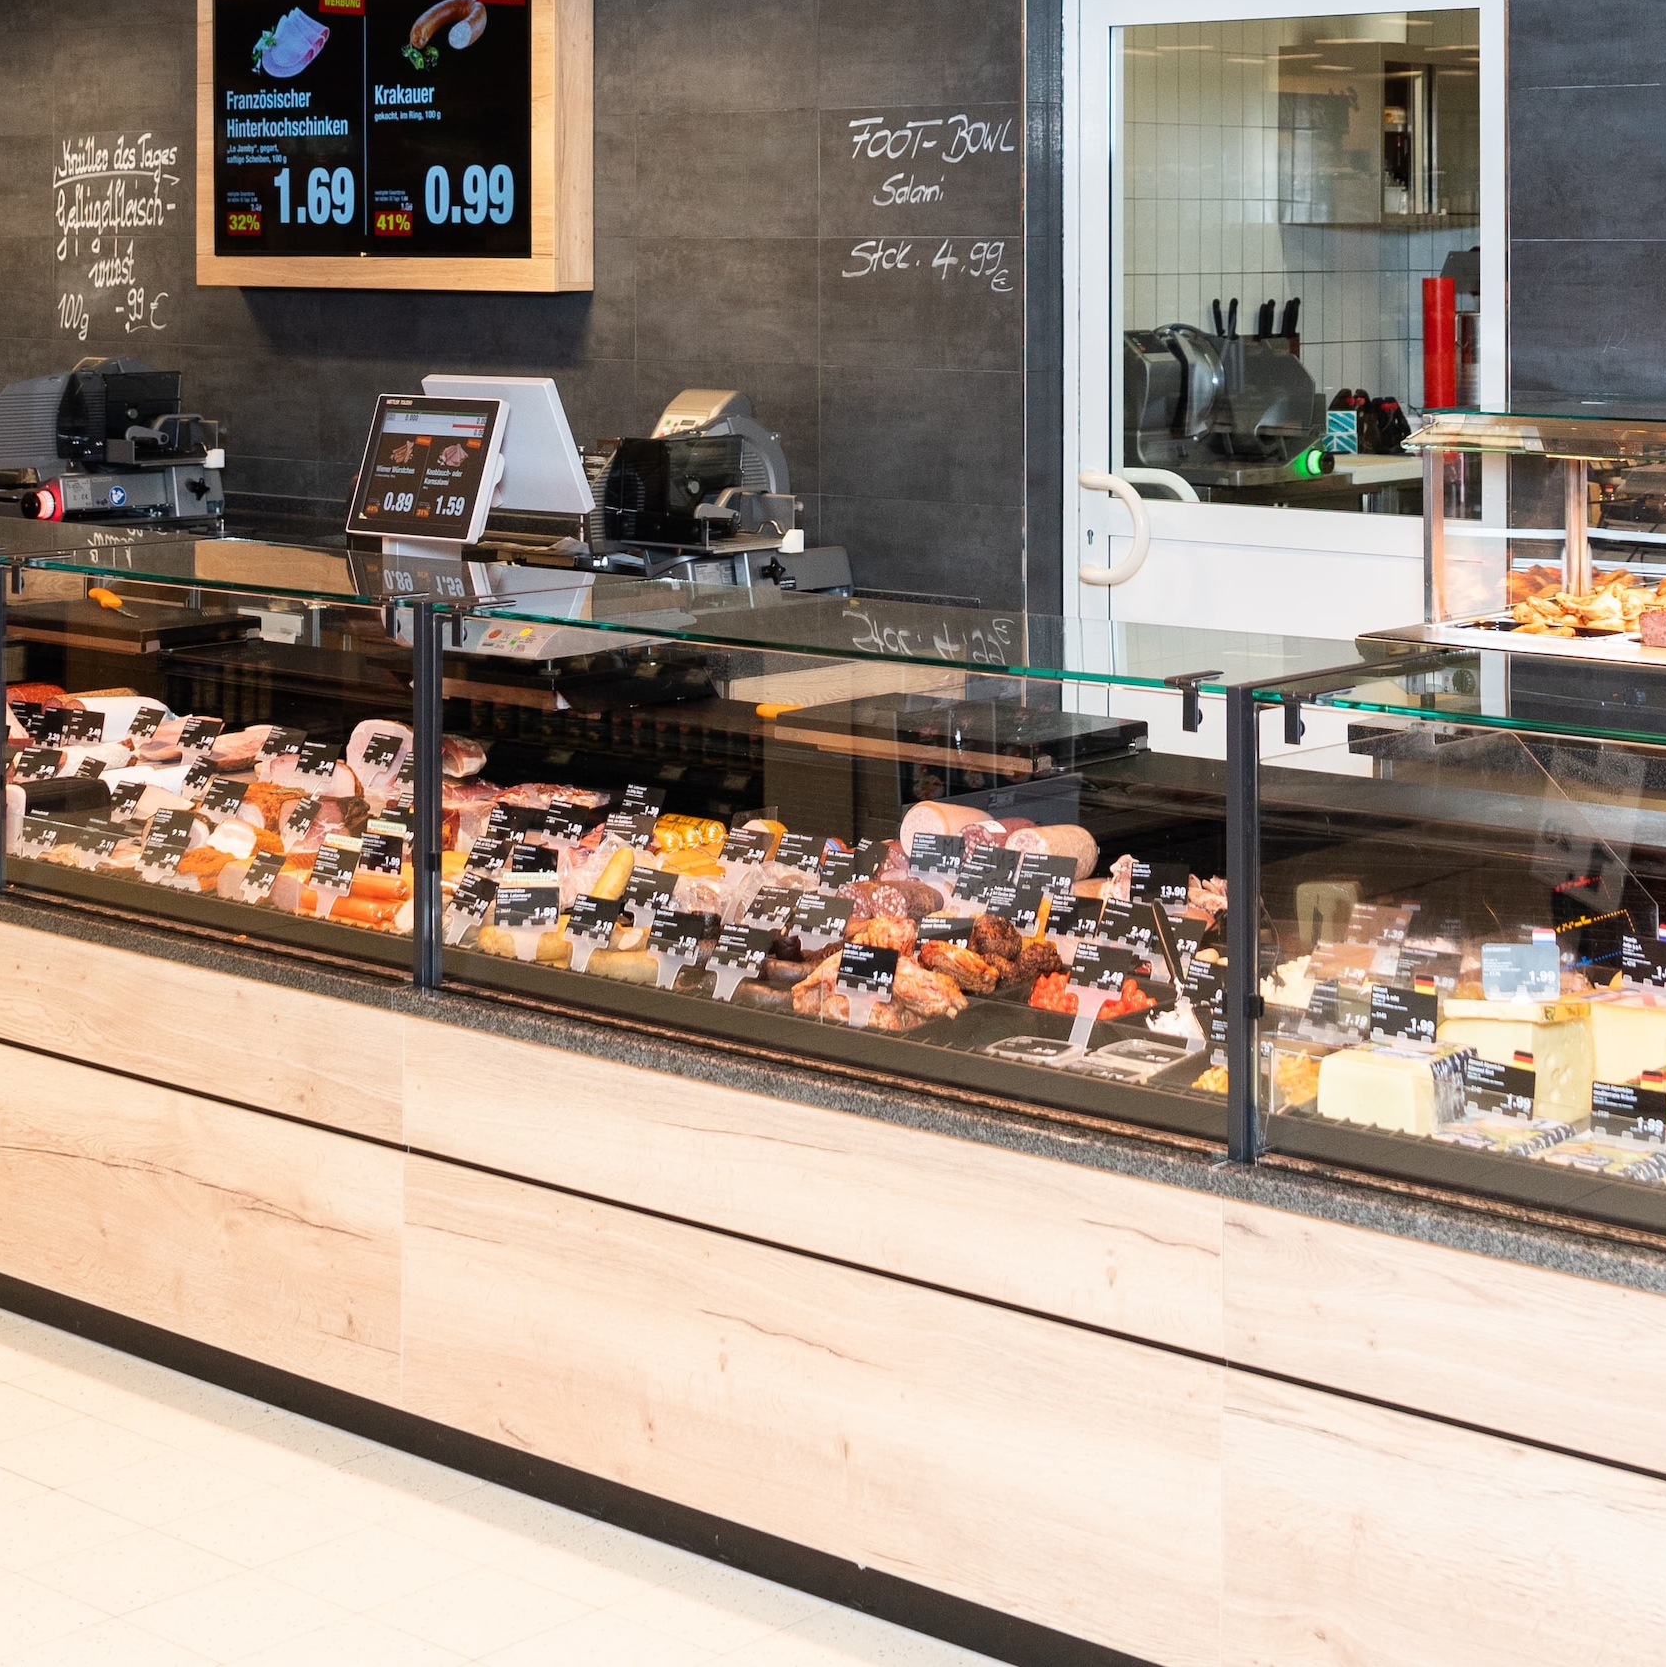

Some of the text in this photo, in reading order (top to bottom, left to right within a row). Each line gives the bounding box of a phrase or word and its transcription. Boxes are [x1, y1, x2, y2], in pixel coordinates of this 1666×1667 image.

[226, 89, 312, 111] Französischer
[374, 83, 435, 106] Krakauer
[226, 116, 348, 138] Hinterkochschinken
[114, 135, 136, 170] des
[138, 133, 178, 183] Tages
[274, 167, 354, 224] 1.69
[425, 164, 514, 224] 0.99
[872, 173, 945, 206] Salami
[229, 215, 260, 230] 32%
[377, 214, 410, 230] 41%
[932, 239, 1005, 280] 4,99
[384, 492, 413, 512] 0.89
[436, 495, 465, 516] 1.59
[1161, 885, 1186, 896] 13.90
